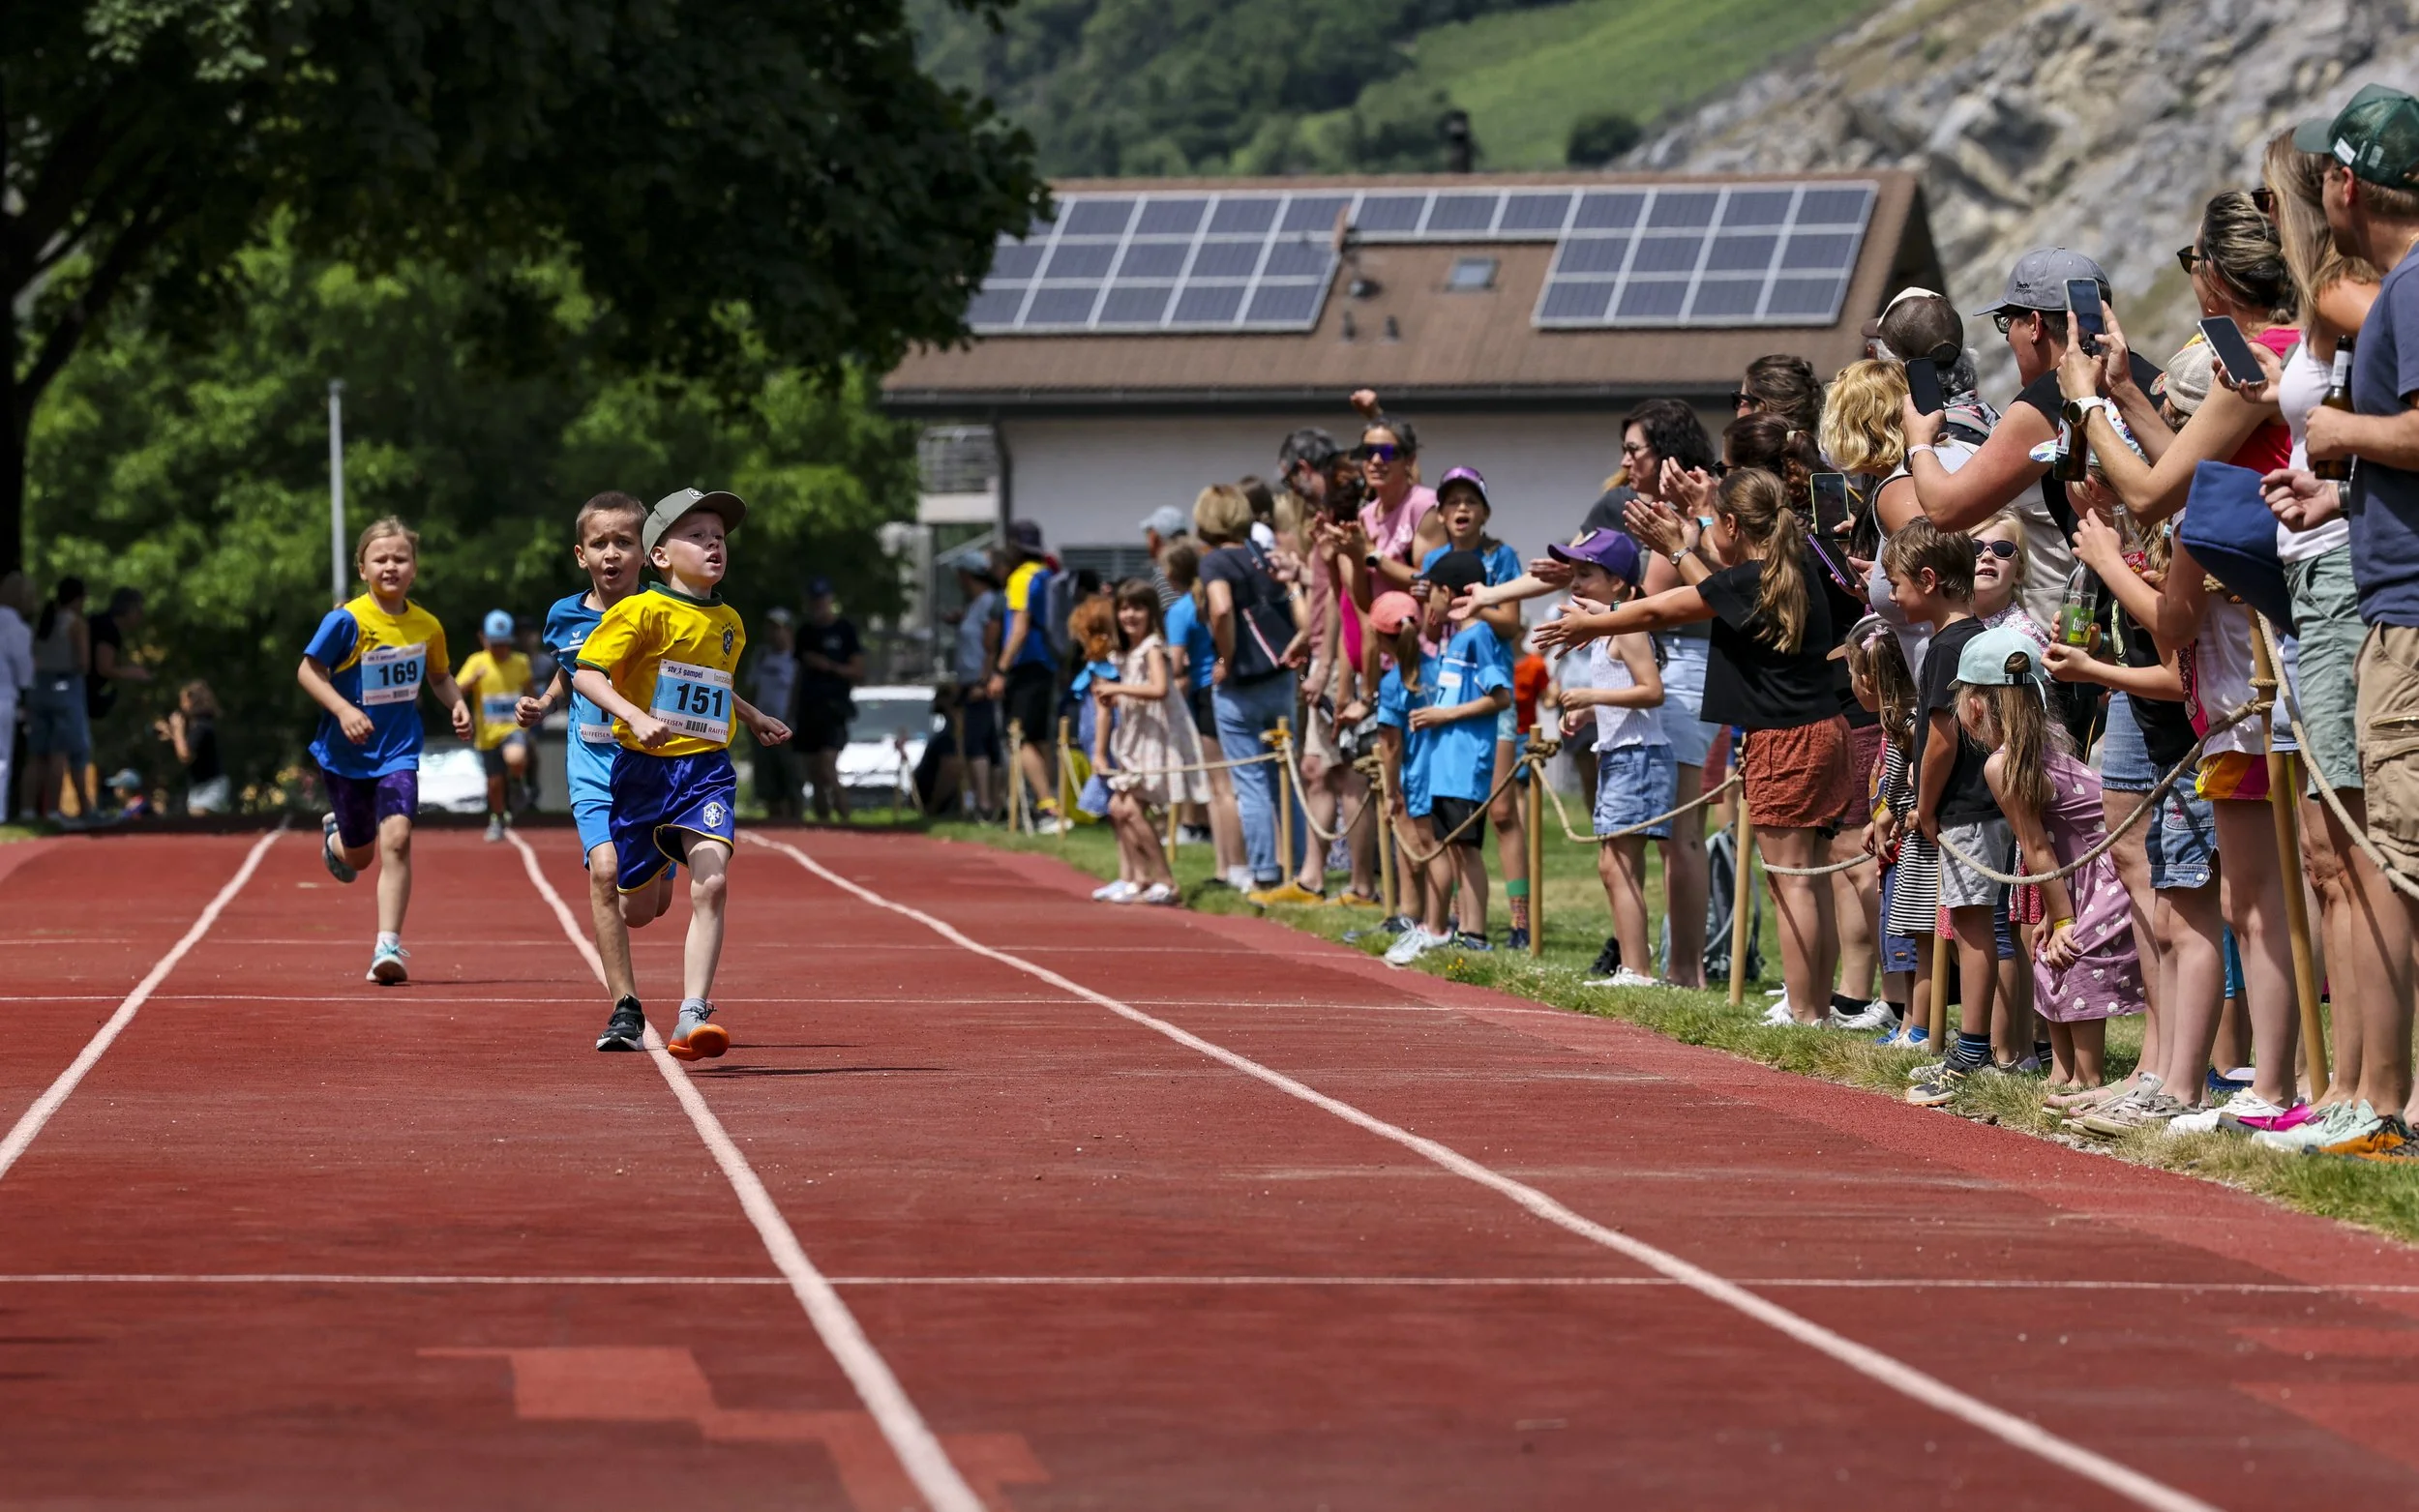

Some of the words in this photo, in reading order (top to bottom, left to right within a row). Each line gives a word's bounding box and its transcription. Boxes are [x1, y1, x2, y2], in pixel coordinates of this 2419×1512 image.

[378, 660, 418, 687] 169
[667, 665, 677, 674] stv
[682, 668, 704, 679] gampel
[676, 682, 724, 718] 151
